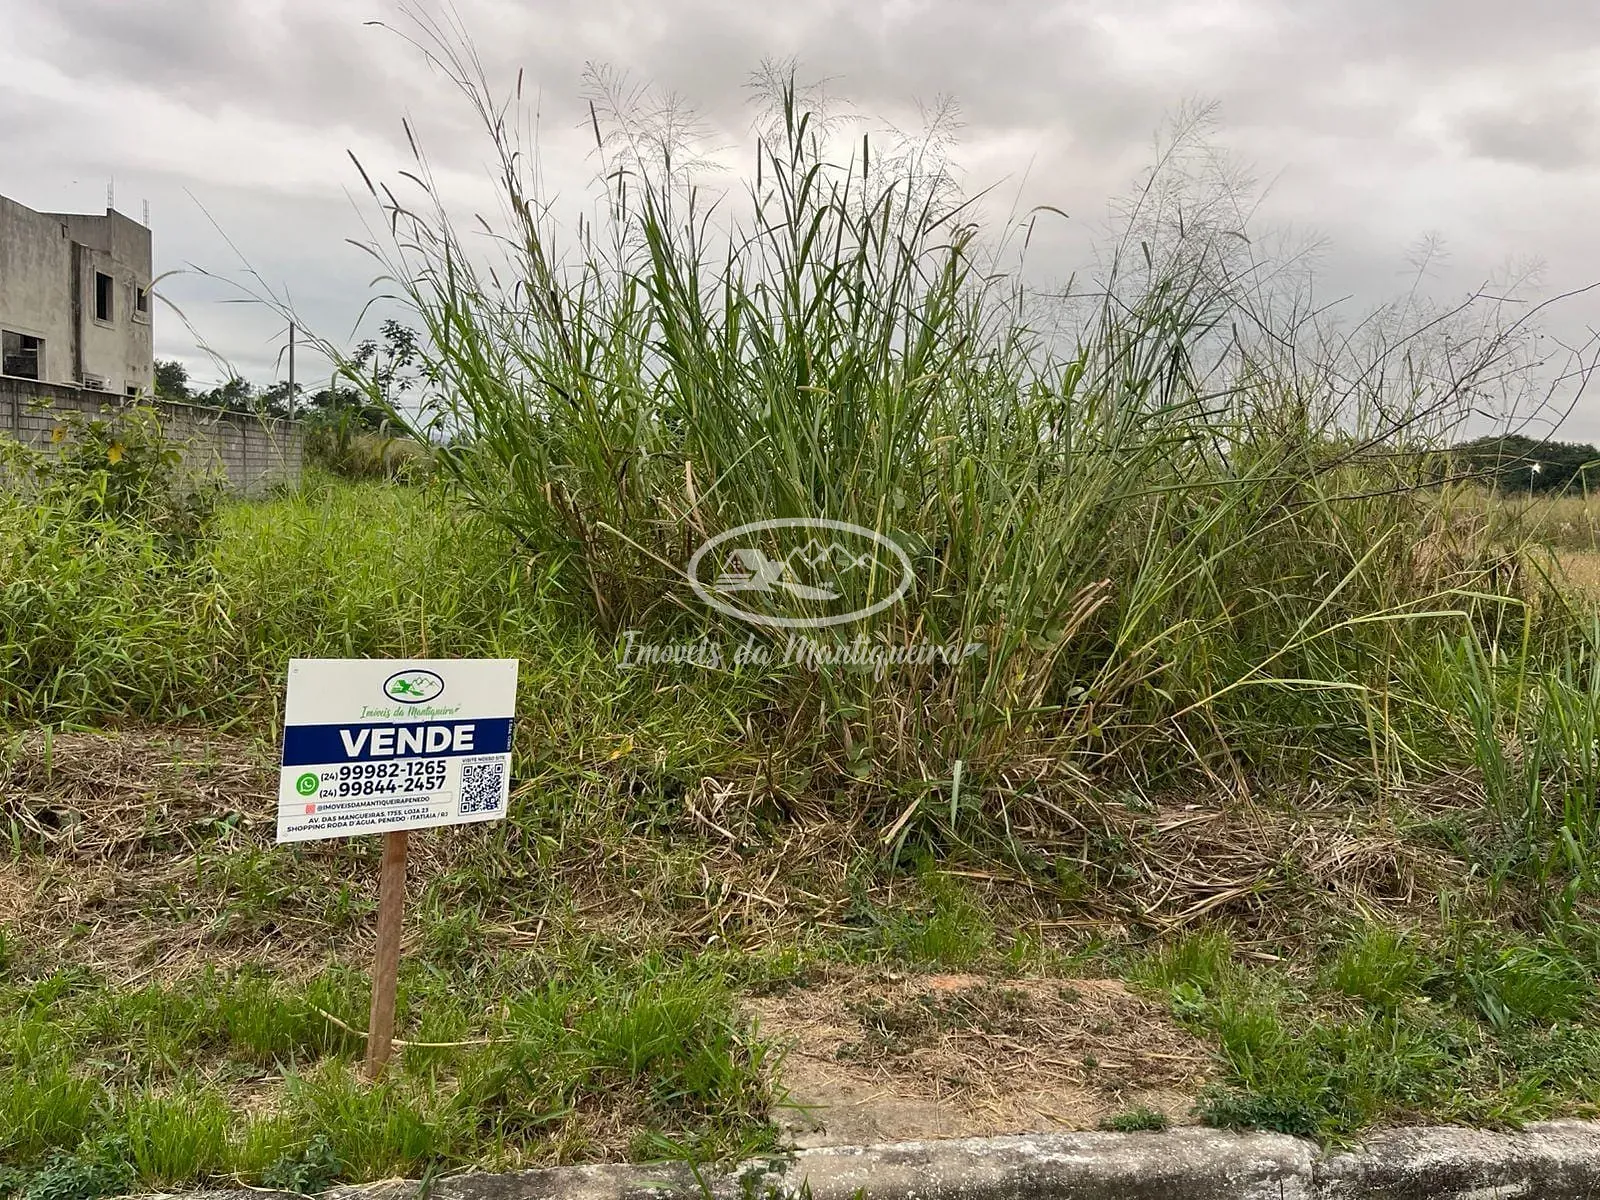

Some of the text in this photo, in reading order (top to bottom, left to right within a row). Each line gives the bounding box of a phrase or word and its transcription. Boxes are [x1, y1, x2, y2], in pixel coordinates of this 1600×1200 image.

[393, 706, 404, 717] da
[339, 724, 475, 757] VENDE
[321, 760, 446, 781] (24) 99982-1265
[319, 775, 446, 798] (24) 99844-2457
[287, 822, 325, 832] SHOPPING
